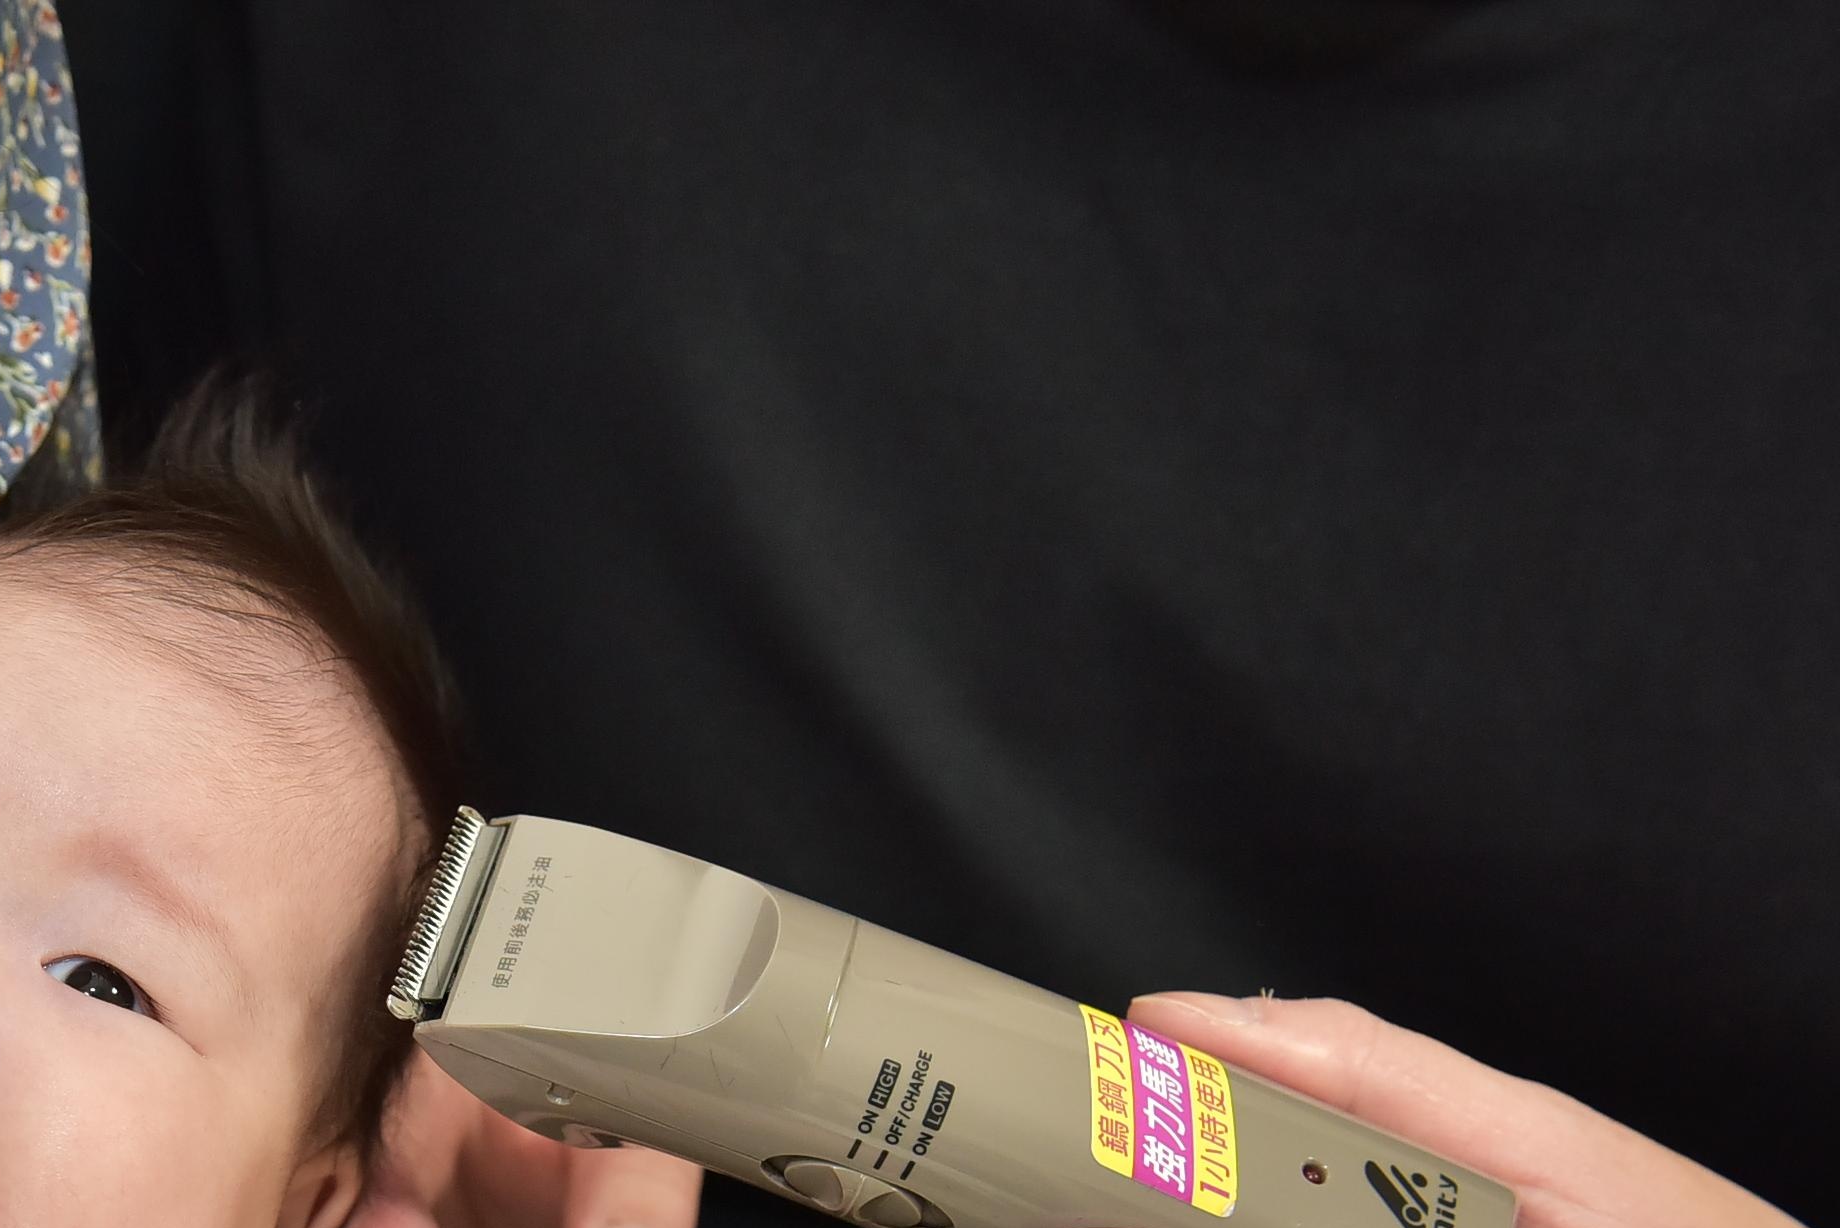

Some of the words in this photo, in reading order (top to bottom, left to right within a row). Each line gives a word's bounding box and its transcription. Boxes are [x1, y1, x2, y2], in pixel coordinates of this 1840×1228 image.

[491, 856, 552, 988] 使用前後務必注油
[858, 1110, 879, 1134] ON
[870, 1060, 900, 1107] HIGH
[885, 1050, 932, 1145] OFF/CHARGE
[912, 1132, 934, 1156] ON
[929, 1084, 953, 1127] LOW
[1088, 1013, 1129, 1157] 鎢鋼刀刃
[1131, 1026, 1186, 1193] 強力馬達
[1189, 1055, 1229, 1198] 1小時使用
